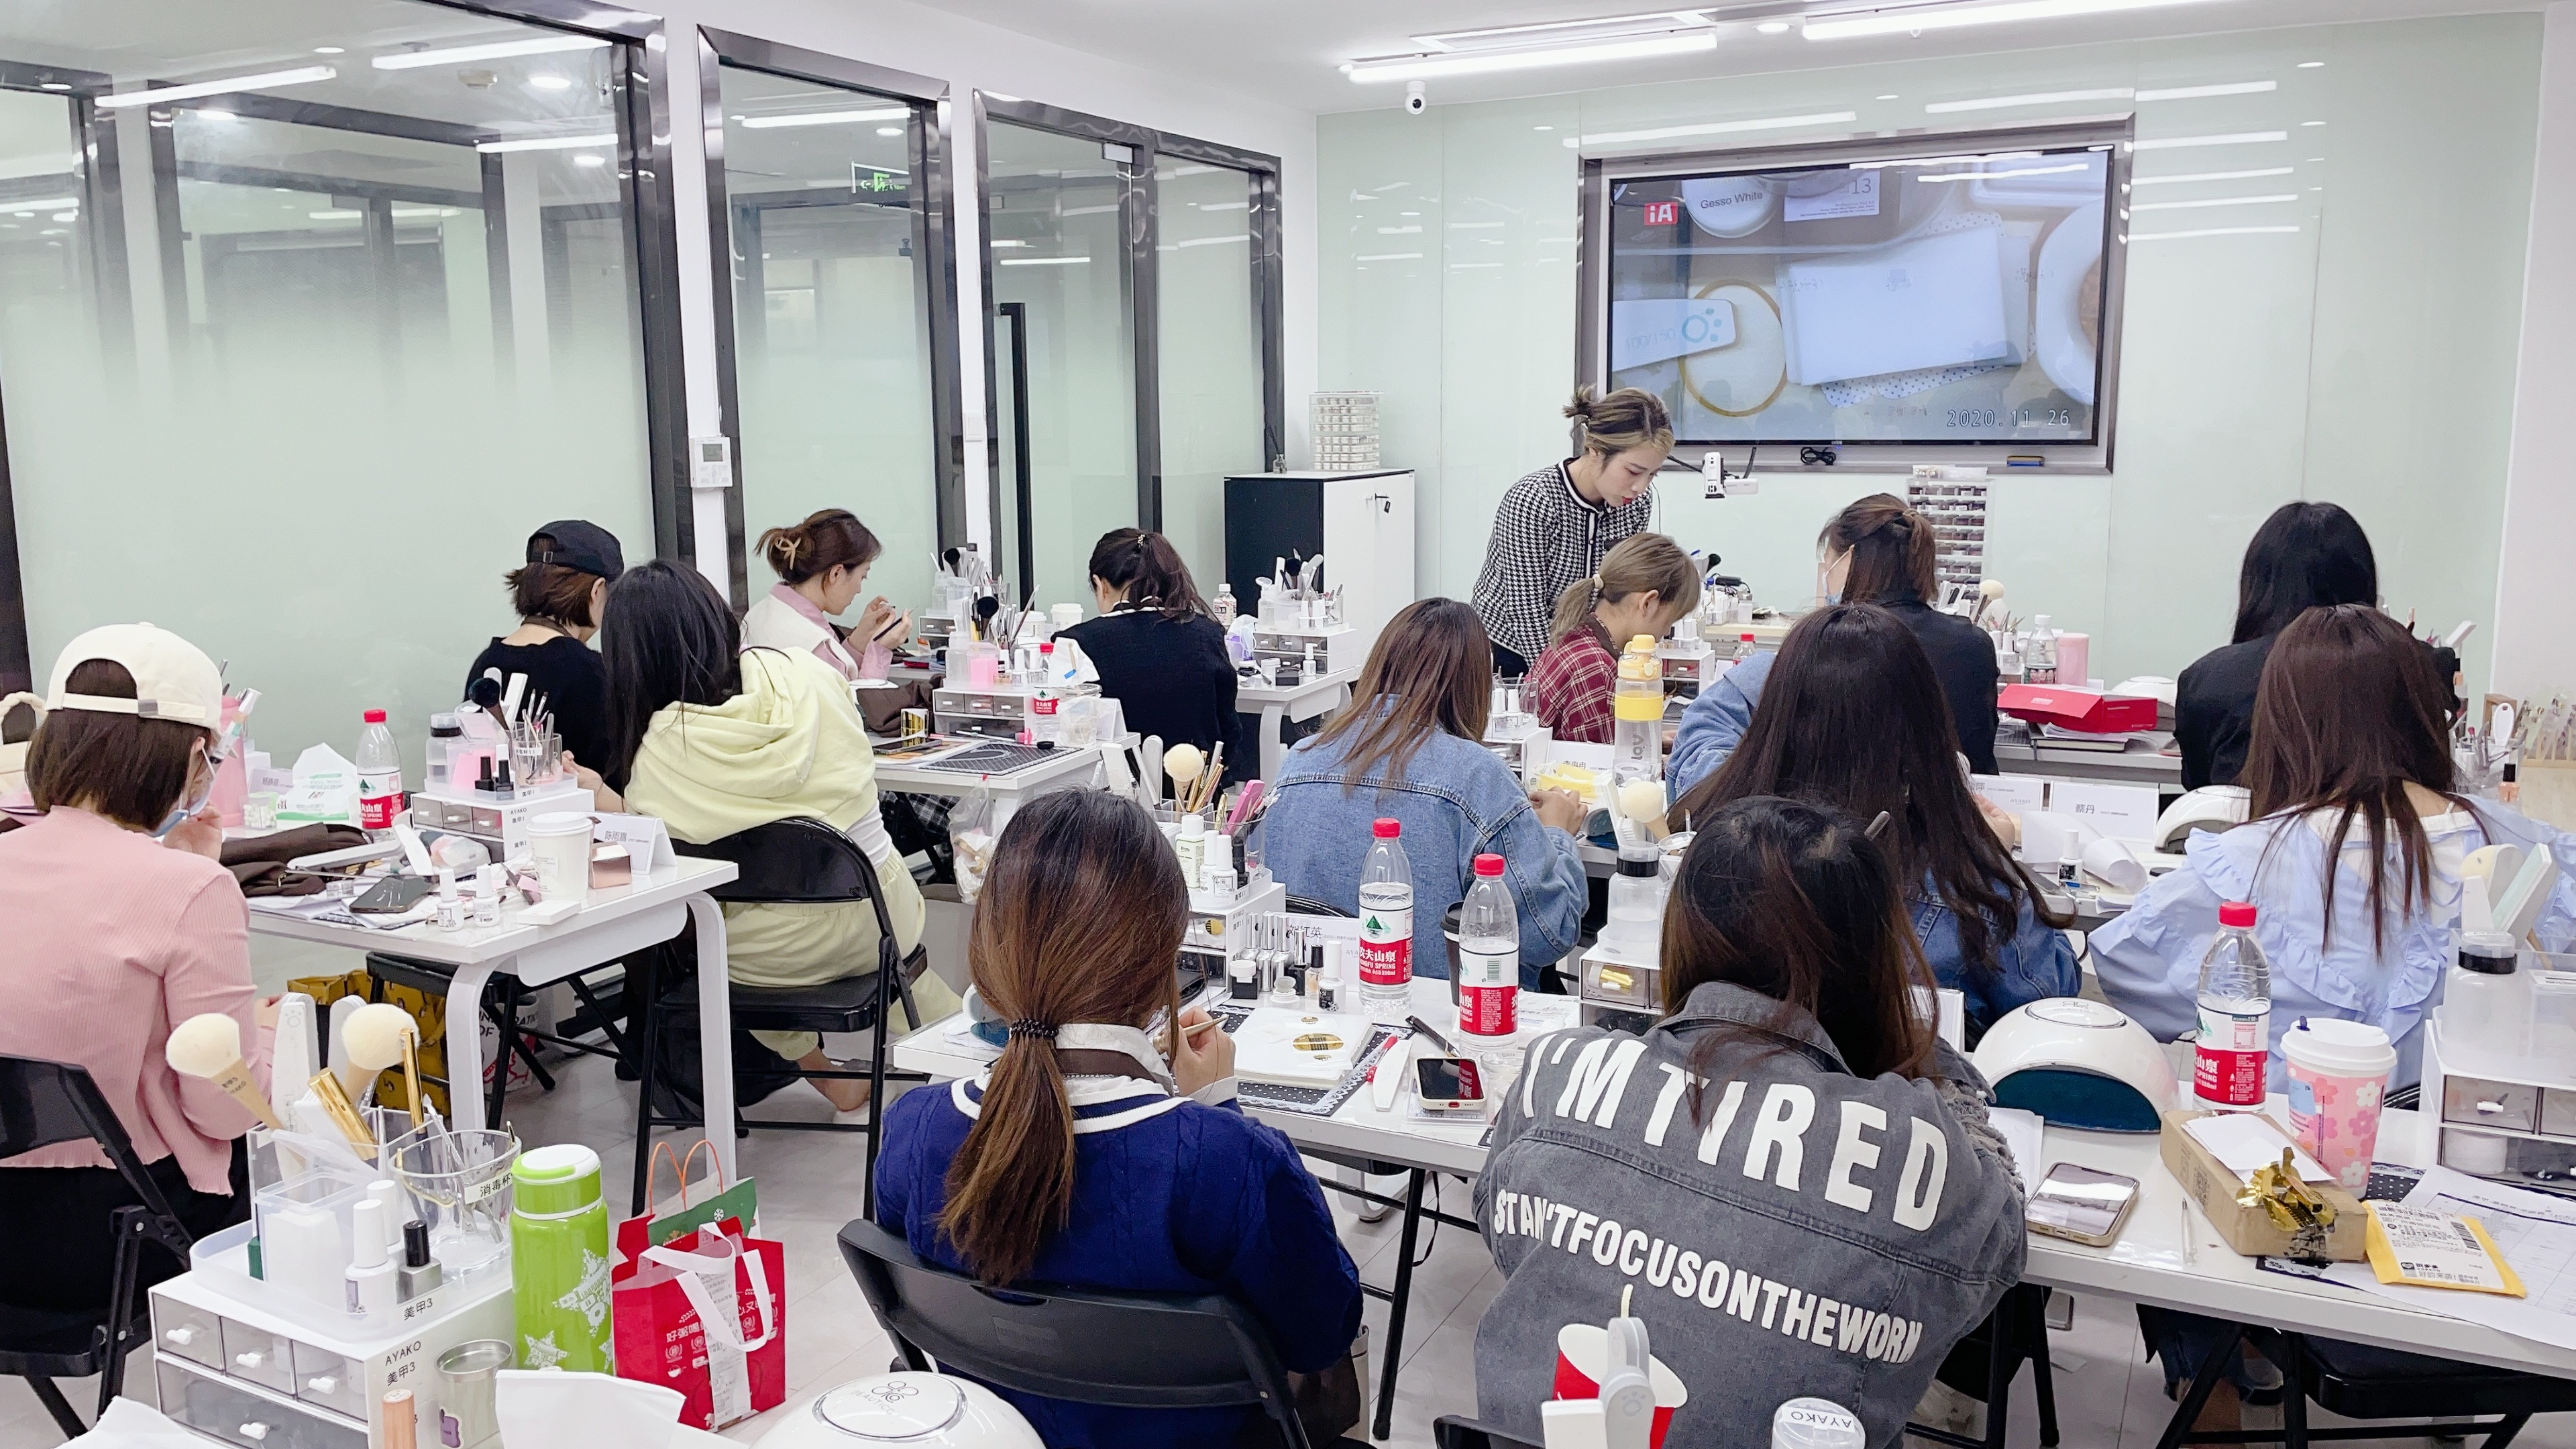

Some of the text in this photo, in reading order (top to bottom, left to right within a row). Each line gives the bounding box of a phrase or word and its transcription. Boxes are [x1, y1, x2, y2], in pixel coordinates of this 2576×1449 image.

[1851, 178, 1872, 195] 13
[1701, 191, 1764, 209] Gesso White
[1649, 203, 1672, 223] iA
[510, 807, 527, 815] AYAKO
[2075, 804, 2095, 814] 蔡丹
[1523, 1034, 1949, 1232] I'M TIRED
[480, 1172, 513, 1197] 消毒杯
[403, 1297, 433, 1321] 美甲3
[385, 1340, 421, 1366] AYAKO
[386, 1361, 416, 1387] 美甲3
[1791, 1411, 1851, 1428] AYAKO
